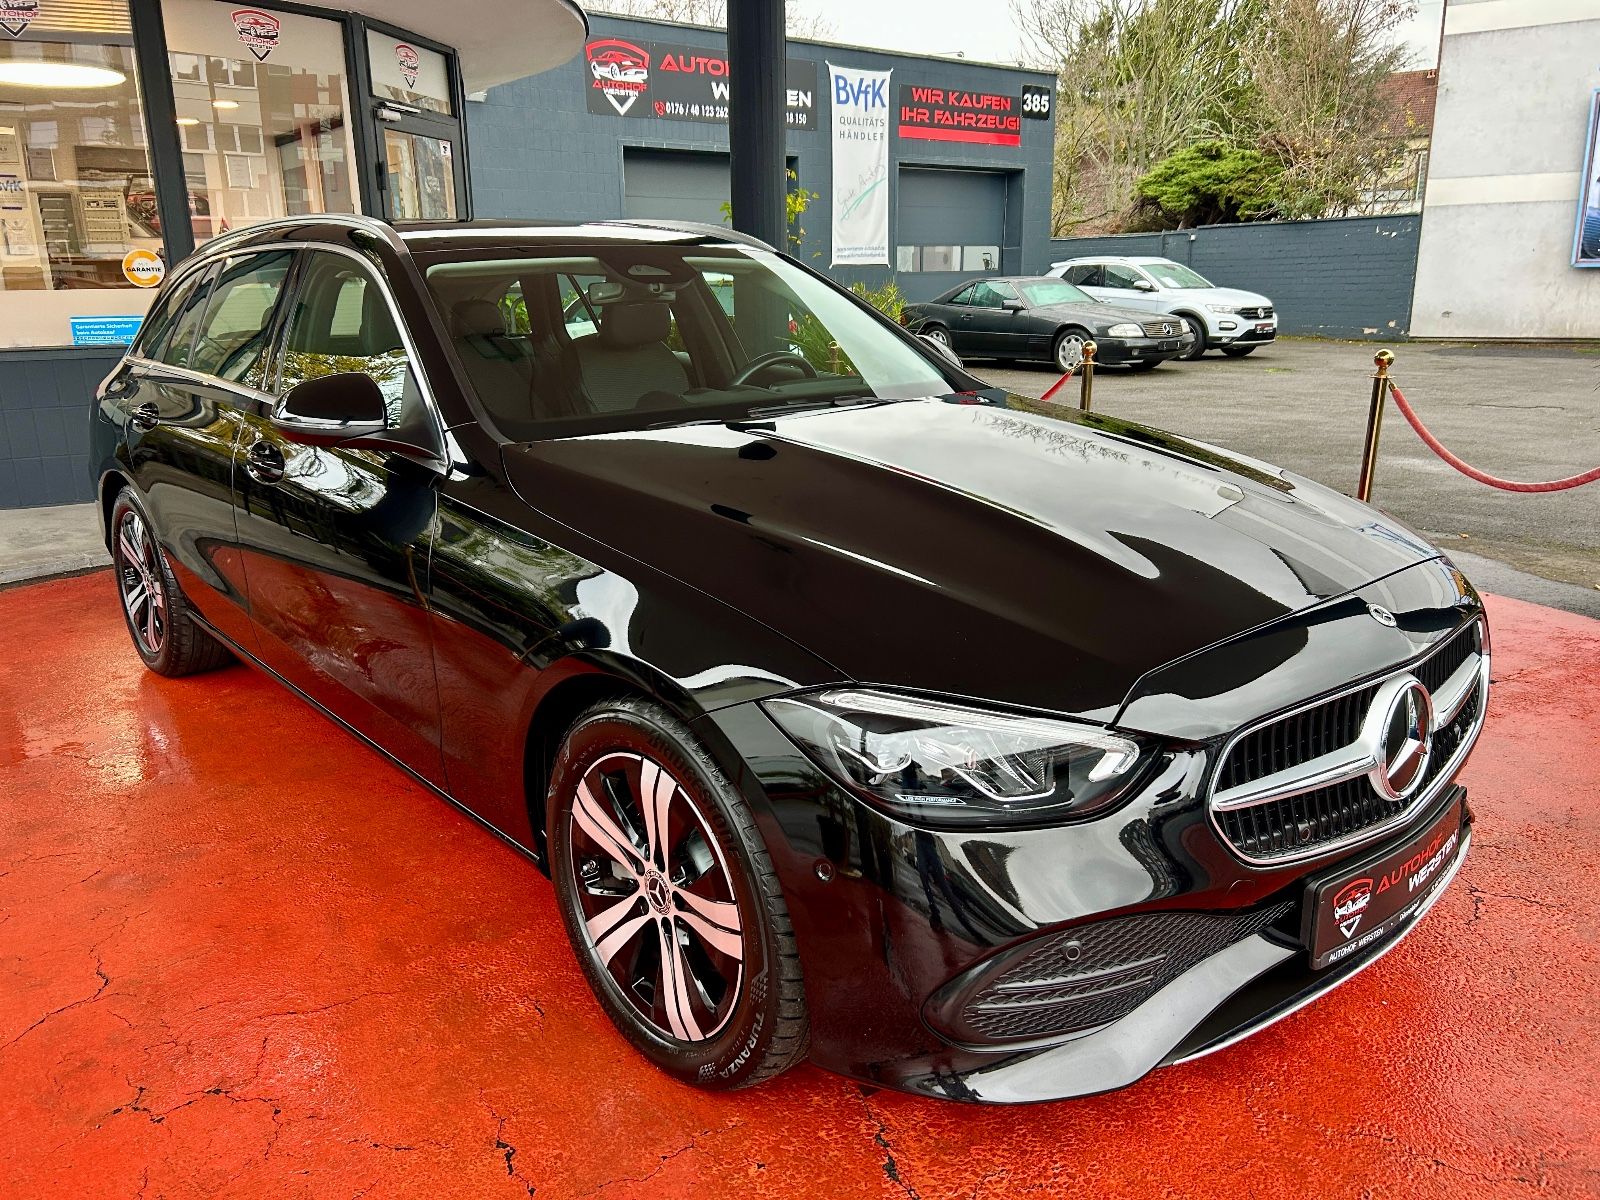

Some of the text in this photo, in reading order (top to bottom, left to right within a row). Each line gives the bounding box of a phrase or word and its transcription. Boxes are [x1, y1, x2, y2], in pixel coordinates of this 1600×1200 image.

[239, 35, 279, 46] AUTOHOF
[592, 79, 648, 92] AUTOHOF
[834, 74, 887, 113] BVfK
[665, 101, 685, 115] 0176
[690, 104, 700, 116] 40
[701, 104, 715, 117] 123
[715, 105, 729, 118] 262
[911, 87, 1011, 111] WIR KAUFEN
[1023, 93, 1050, 113] 385
[839, 116, 885, 127] QUALITÄTS
[901, 106, 1020, 131] IHR FAHRZEUG!
[839, 129, 884, 141] HÄNDLER
[1376, 832, 1442, 895] AUTOHOF
[1408, 828, 1459, 893] WERSTEN
[1334, 904, 1369, 926] AUTOHOF
[1328, 941, 1358, 963] AUTOHOF
[1358, 926, 1384, 947] WERSTEN
[719, 1012, 765, 1078] TURANZA
